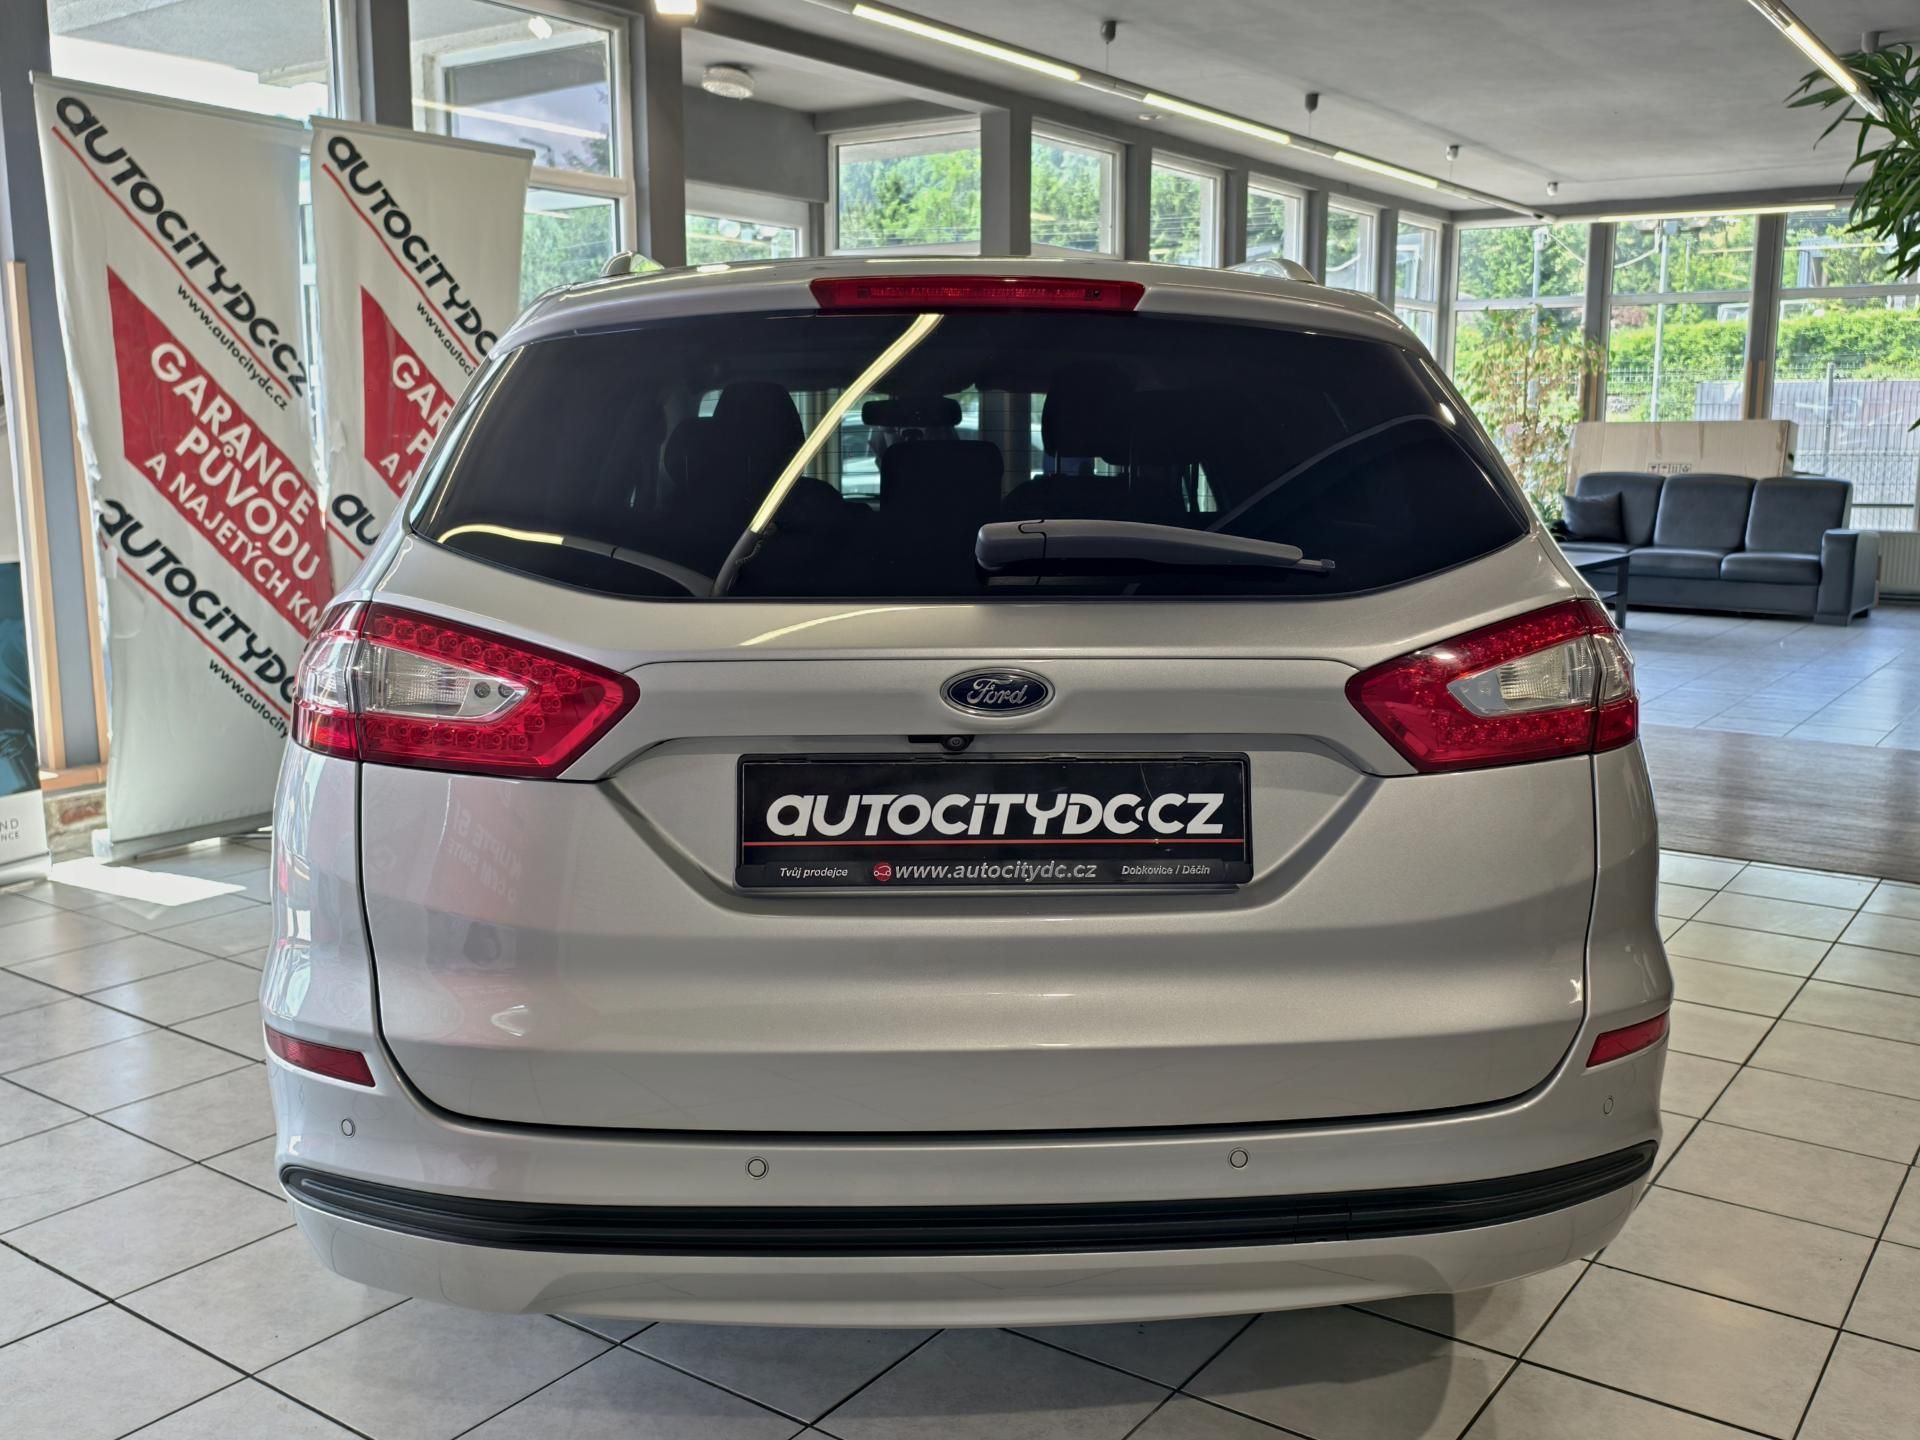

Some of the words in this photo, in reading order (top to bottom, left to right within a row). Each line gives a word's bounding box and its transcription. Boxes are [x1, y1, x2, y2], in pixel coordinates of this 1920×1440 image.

[177, 284, 288, 411] www.autocitydc.cz
[151, 342, 315, 526] GARANCE
[379, 453, 400, 478] A
[175, 425, 321, 581] PŮVODU
[144, 452, 167, 481] A
[168, 472, 291, 598] NAJETÝCH
[966, 677, 1027, 706] Ford
[779, 867, 801, 879] Tvůj
[803, 867, 848, 879] prodejce
[895, 860, 1097, 882] www.autocitydc.cz
[1121, 865, 1174, 876] Dobkovice
